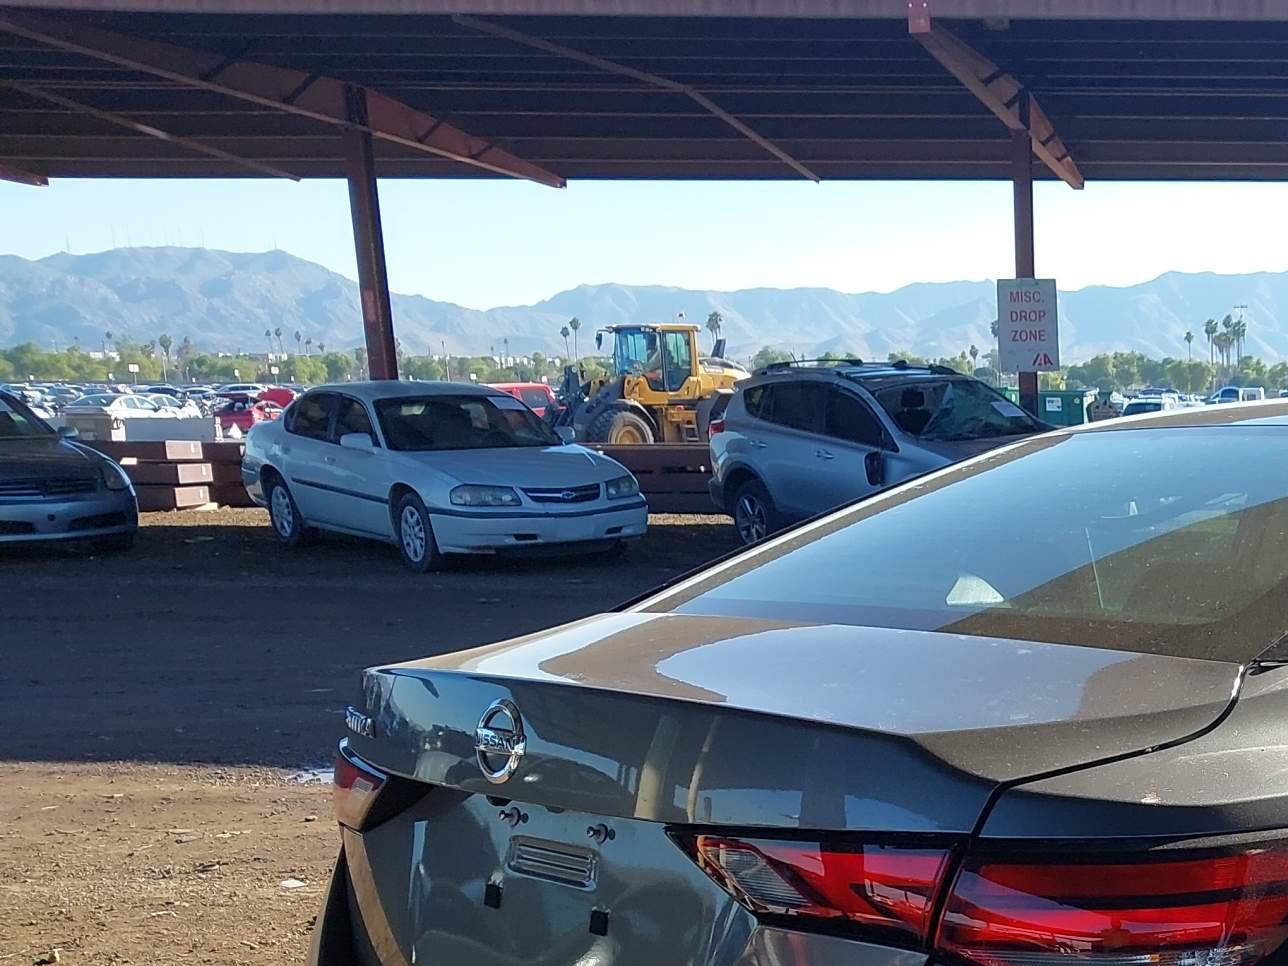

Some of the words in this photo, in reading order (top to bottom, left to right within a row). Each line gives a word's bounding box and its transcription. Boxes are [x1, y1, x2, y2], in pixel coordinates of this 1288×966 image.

[1009, 291, 1046, 303] MISC.
[1010, 310, 1046, 322] DROP
[1011, 330, 1046, 342] ZONE
